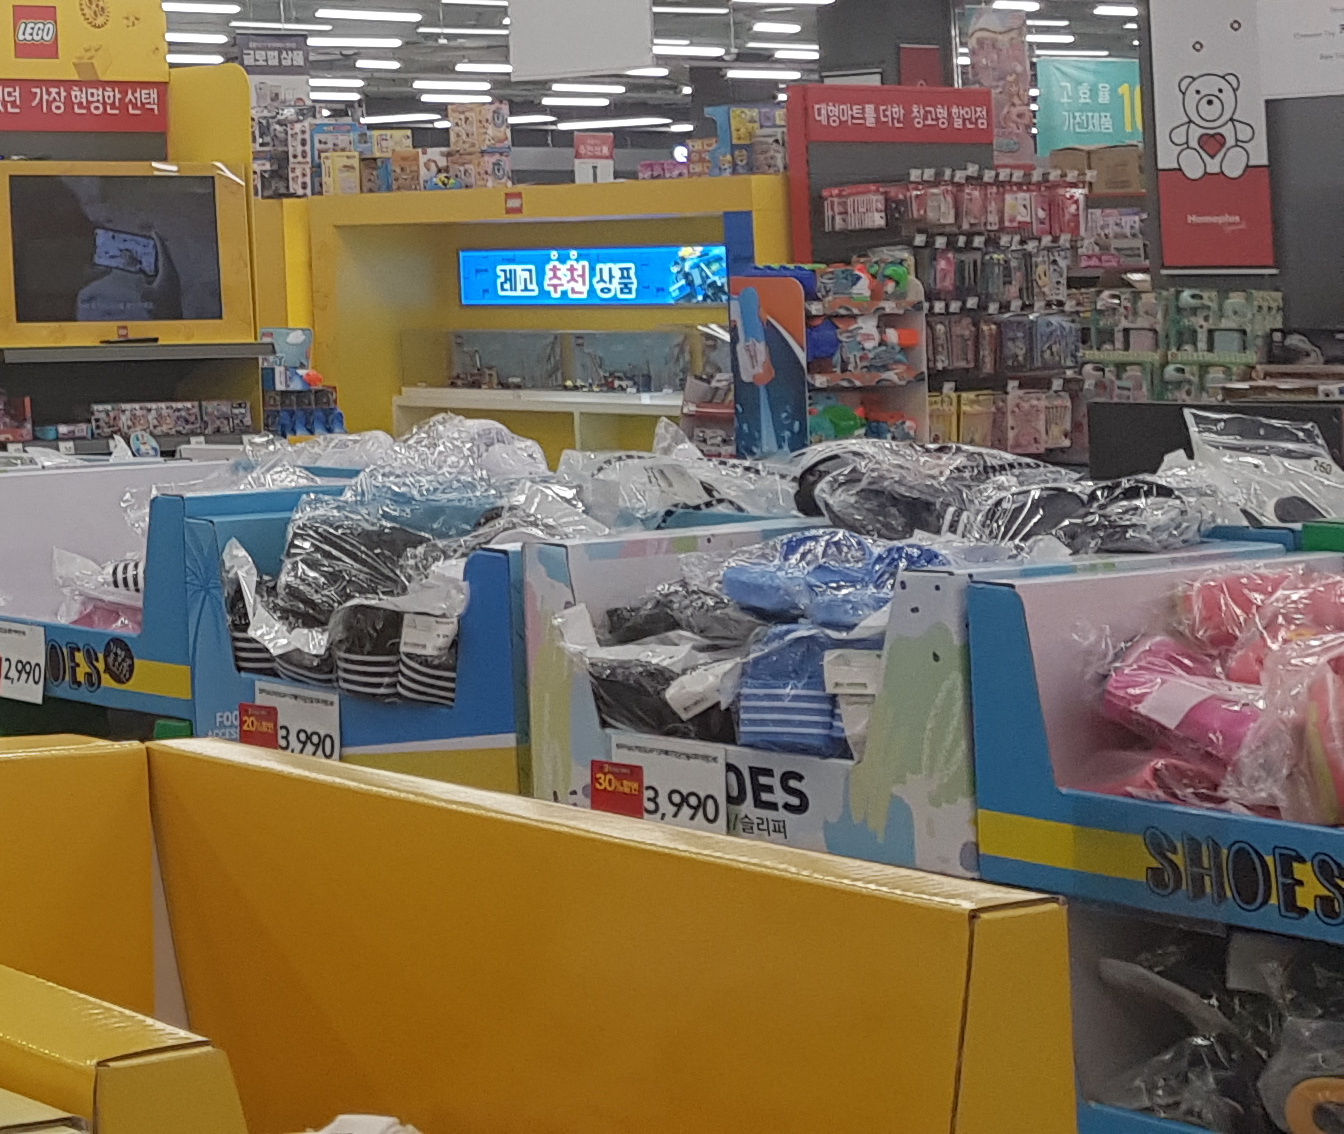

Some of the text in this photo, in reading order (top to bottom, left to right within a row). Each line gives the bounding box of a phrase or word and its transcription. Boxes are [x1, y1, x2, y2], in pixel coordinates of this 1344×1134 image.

[16, 20, 56, 44] LEGO
[31, 86, 67, 114] 가장
[71, 86, 122, 115] 현명한
[125, 87, 159, 115] 선택
[814, 103, 988, 129] 대형마트를 더한 창고형 할인점
[1062, 112, 1112, 132] 가전제품
[498, 261, 637, 297] 레고 추천 상품
[3, 658, 42, 685] 2,990
[279, 725, 335, 759] 3,990
[644, 785, 720, 824] 3,990
[1142, 824, 1344, 924] SHOES
